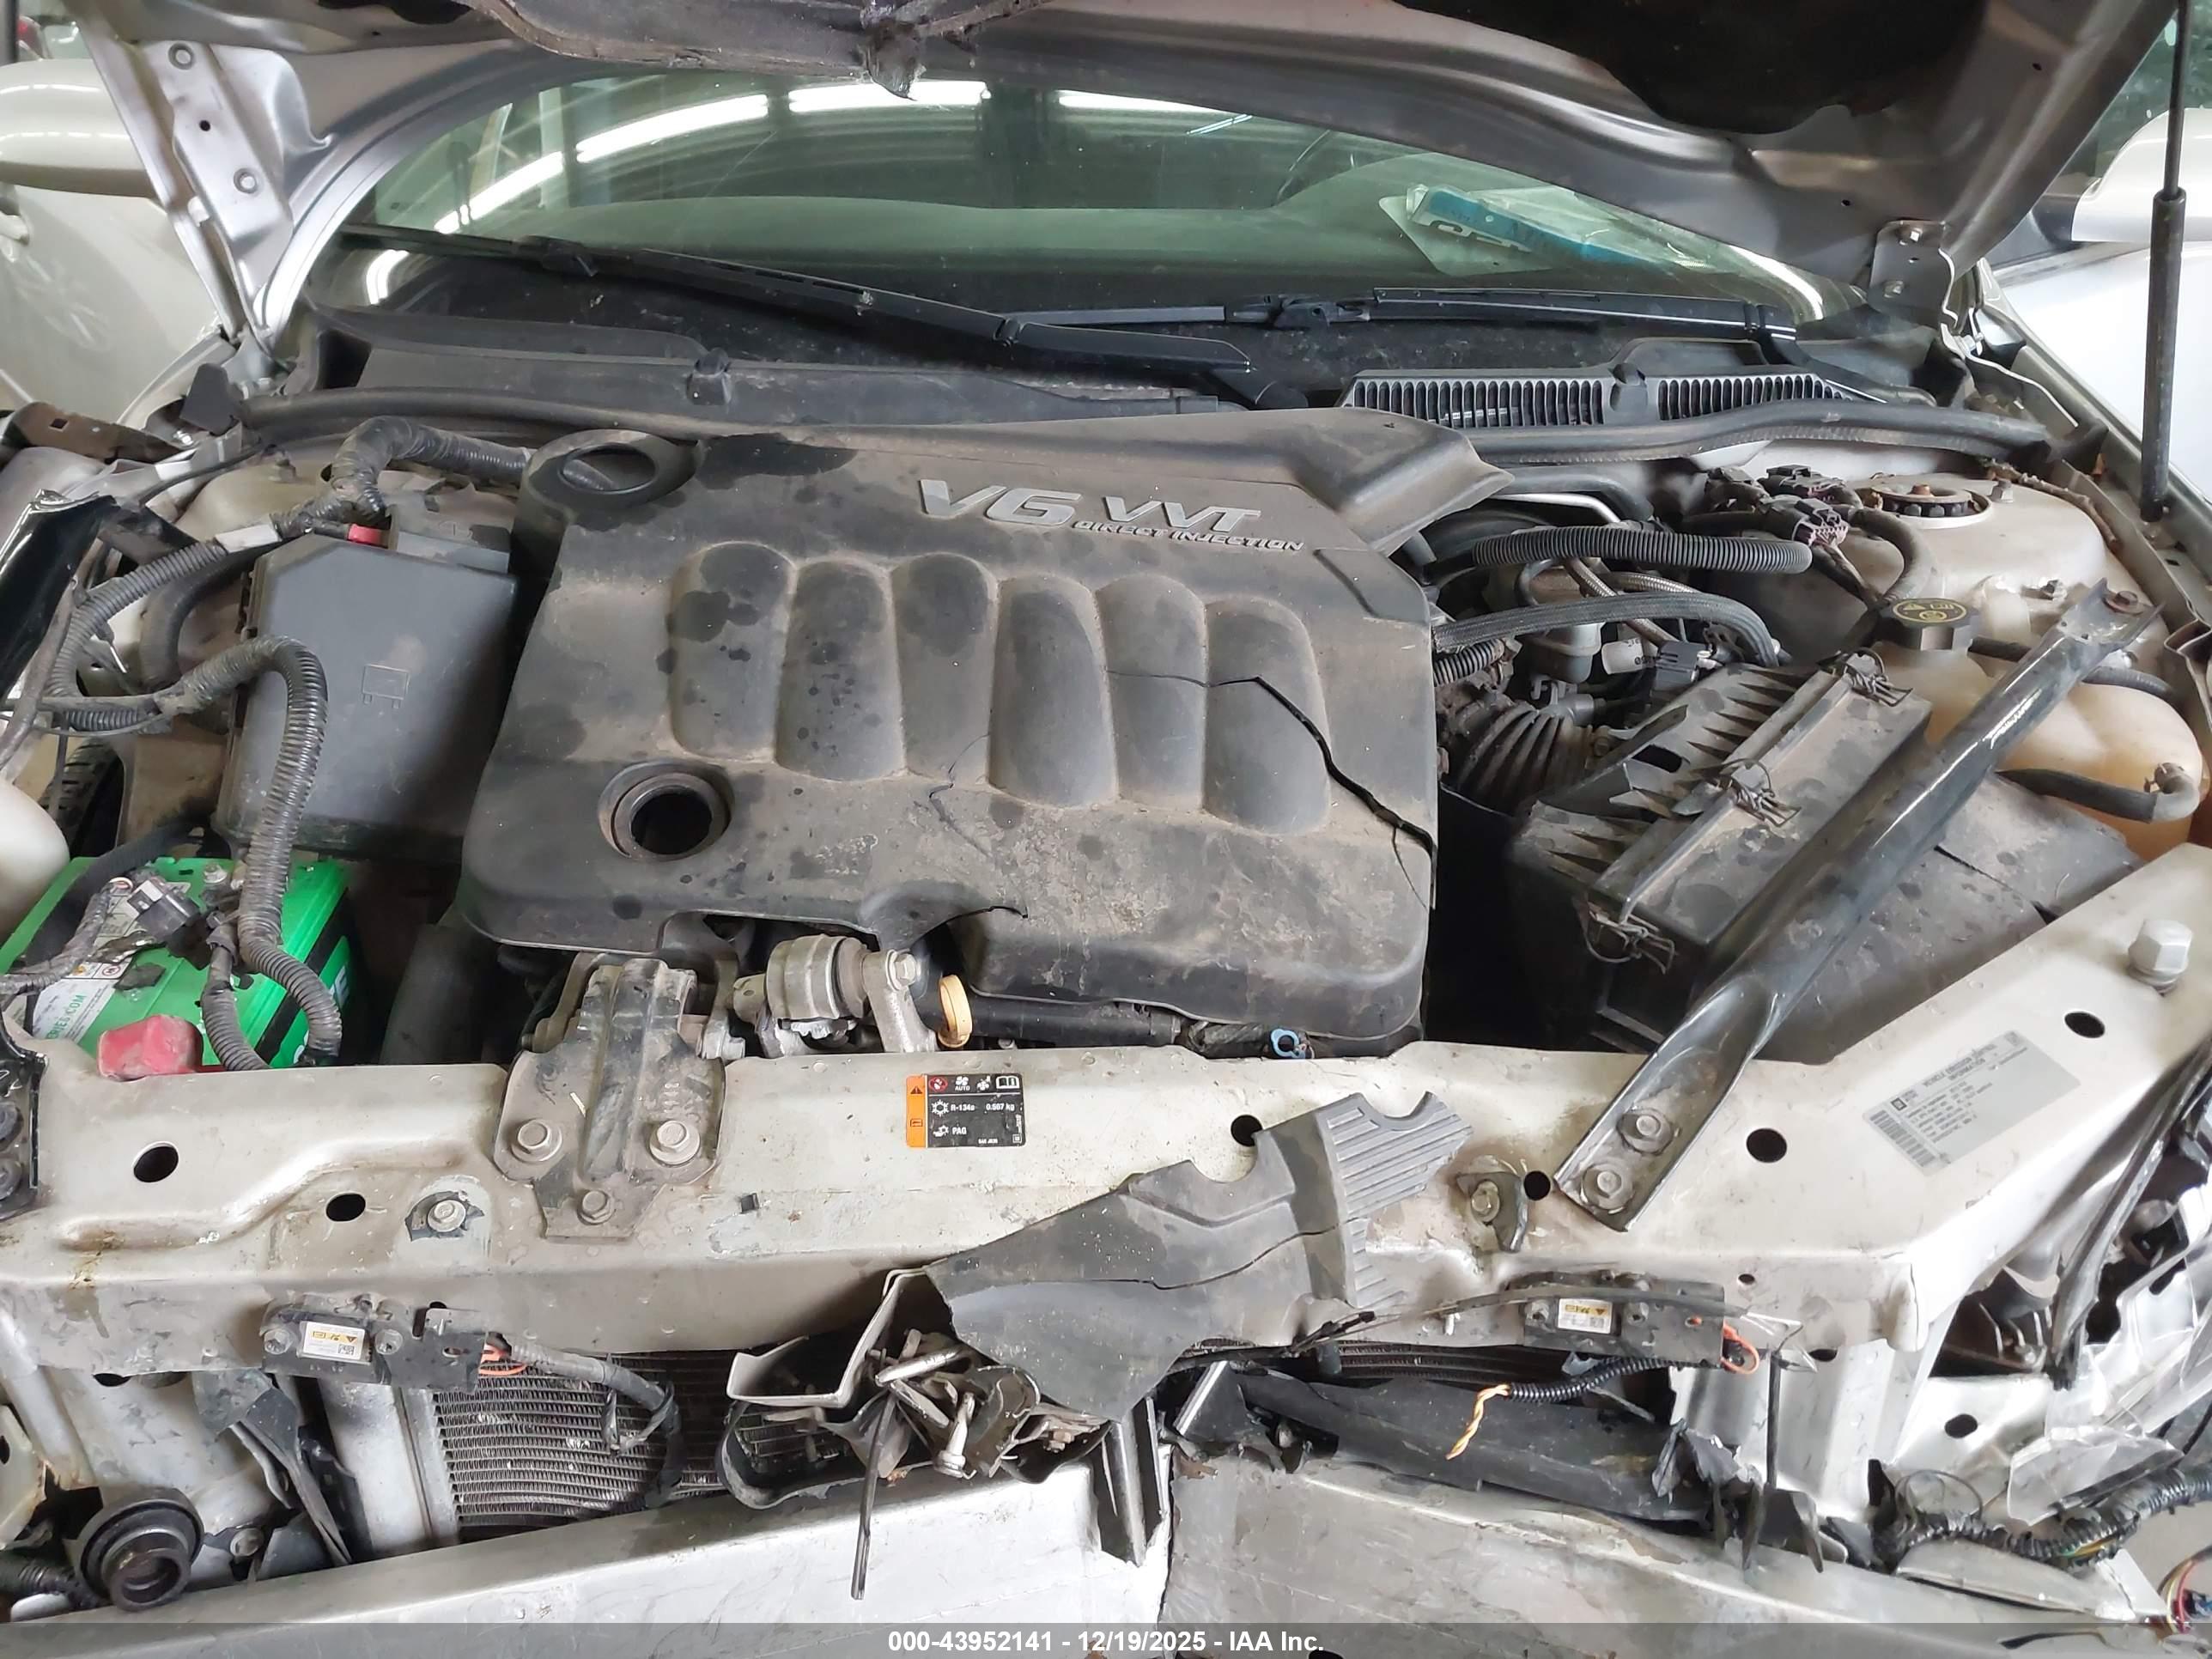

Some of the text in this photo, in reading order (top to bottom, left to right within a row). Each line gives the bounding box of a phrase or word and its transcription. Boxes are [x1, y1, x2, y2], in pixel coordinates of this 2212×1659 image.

[919, 478, 1261, 532] V6 VVT
[1073, 520, 1304, 551] DIRECT INJECTION
[951, 1127, 967, 1135] PAG
